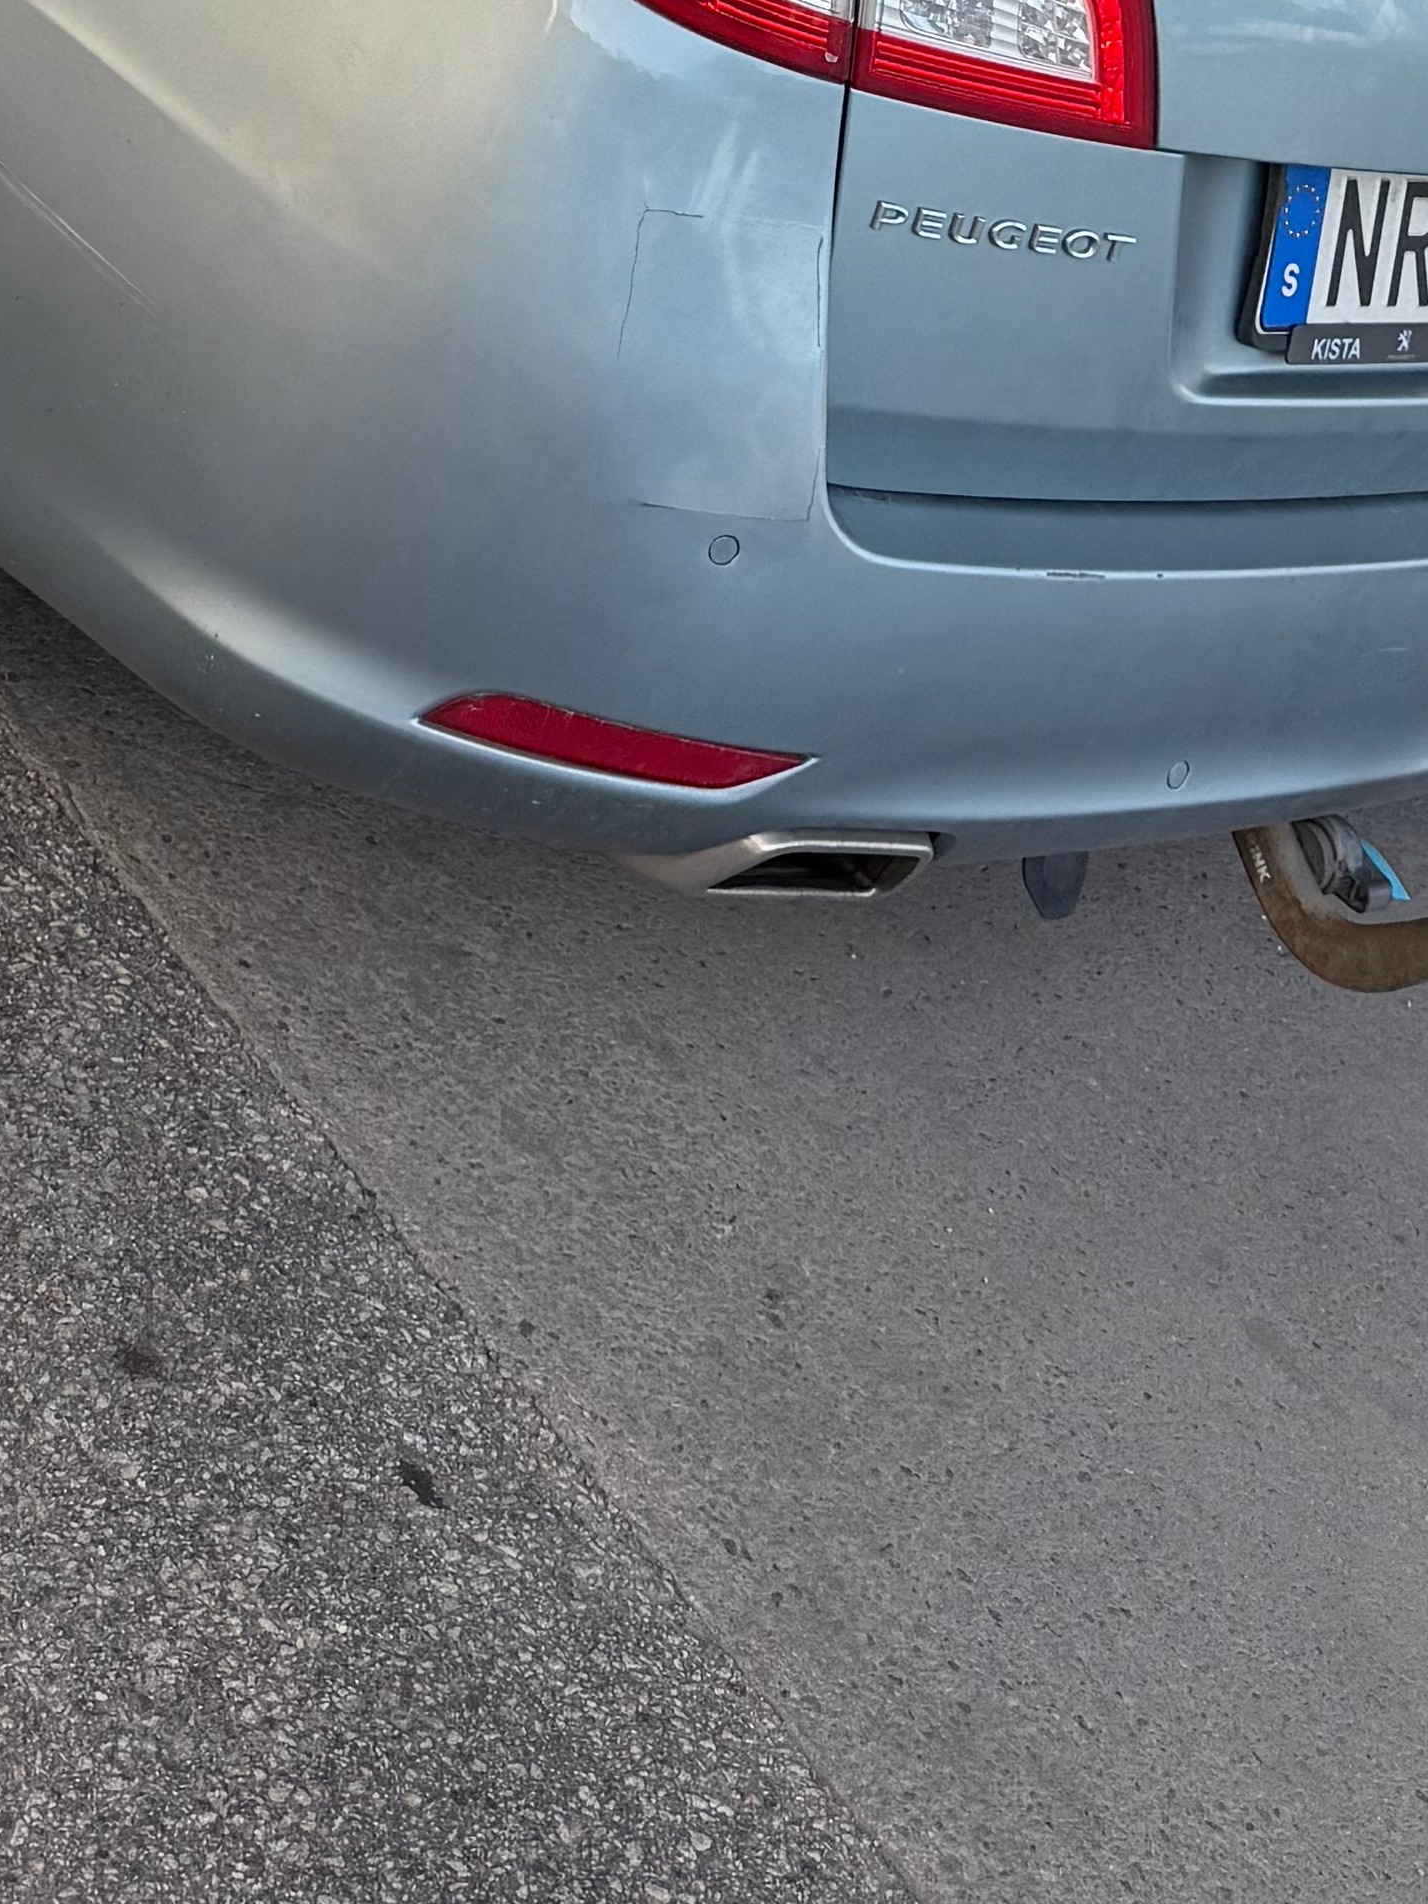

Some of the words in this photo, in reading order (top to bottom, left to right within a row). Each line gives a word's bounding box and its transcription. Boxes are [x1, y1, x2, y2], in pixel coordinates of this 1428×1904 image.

[870, 199, 1137, 263] PEUGEOT
[1281, 263, 1301, 298] S
[1311, 338, 1361, 360] KISTA
